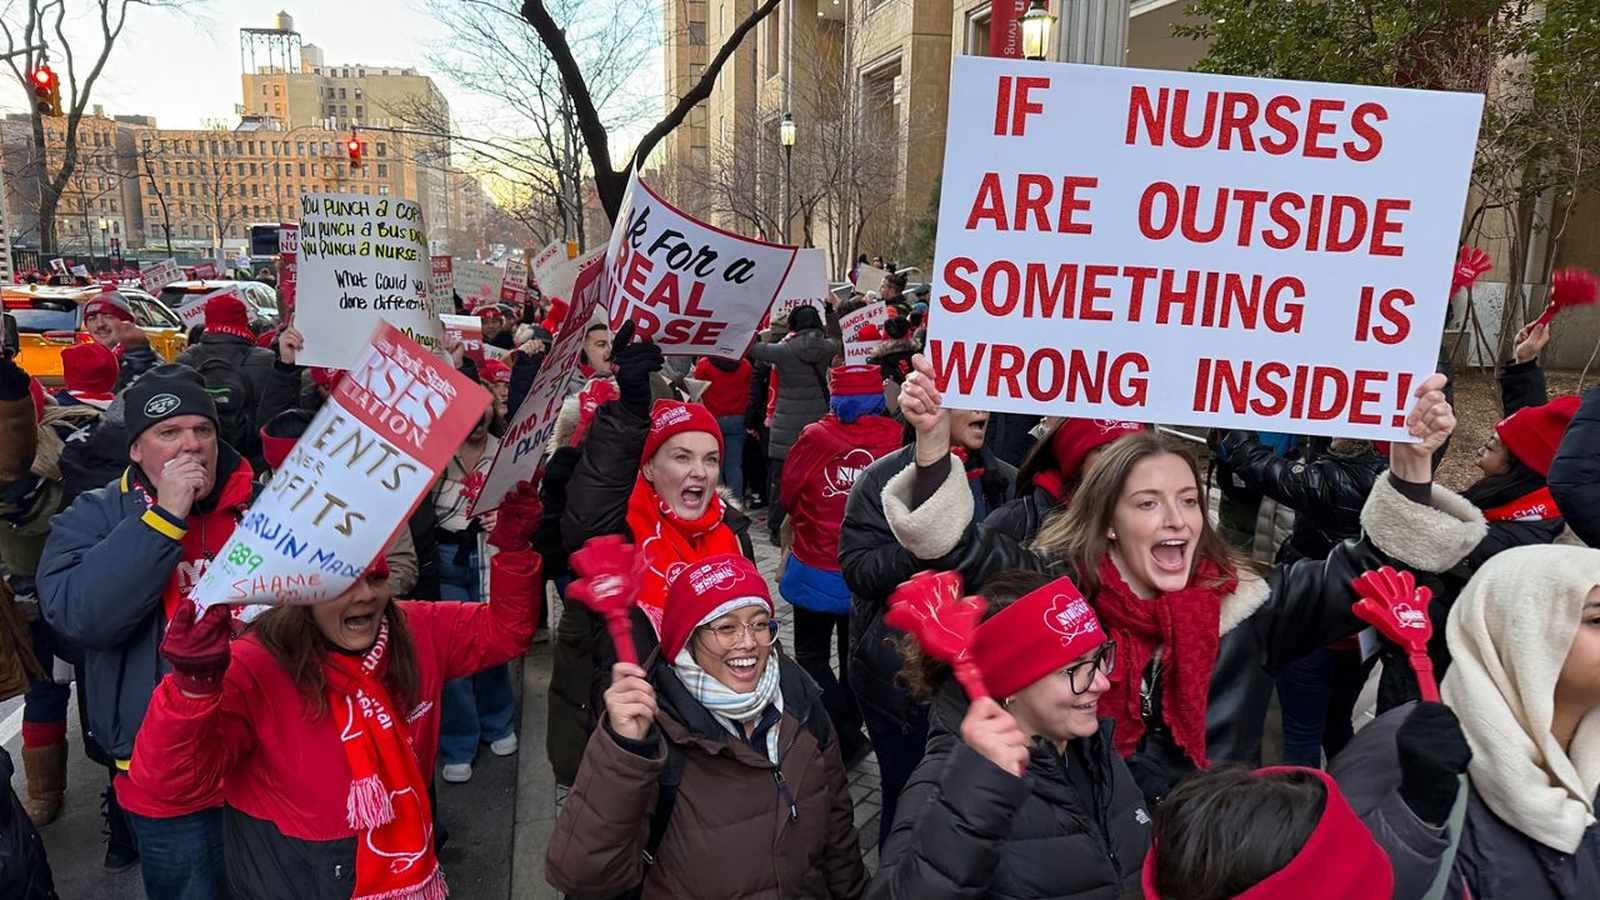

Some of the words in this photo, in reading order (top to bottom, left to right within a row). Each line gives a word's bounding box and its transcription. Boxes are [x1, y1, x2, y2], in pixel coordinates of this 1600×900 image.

[994, 76, 1050, 136] IF
[1125, 86, 1388, 162] NURSES
[319, 221, 355, 240] PUNCH
[324, 200, 370, 217] PUNCH
[965, 172, 1098, 234] ARE
[1138, 181, 1411, 257] OUTSIDE
[320, 242, 356, 259] PUNCH
[723, 256, 756, 285] a
[614, 238, 714, 318] REAL
[939, 257, 1305, 333] SOMETHING
[1355, 287, 1416, 344] IS
[930, 339, 1150, 407] WRONG
[1193, 358, 1413, 428] INSIDE!
[226, 573, 321, 600] SHAME
